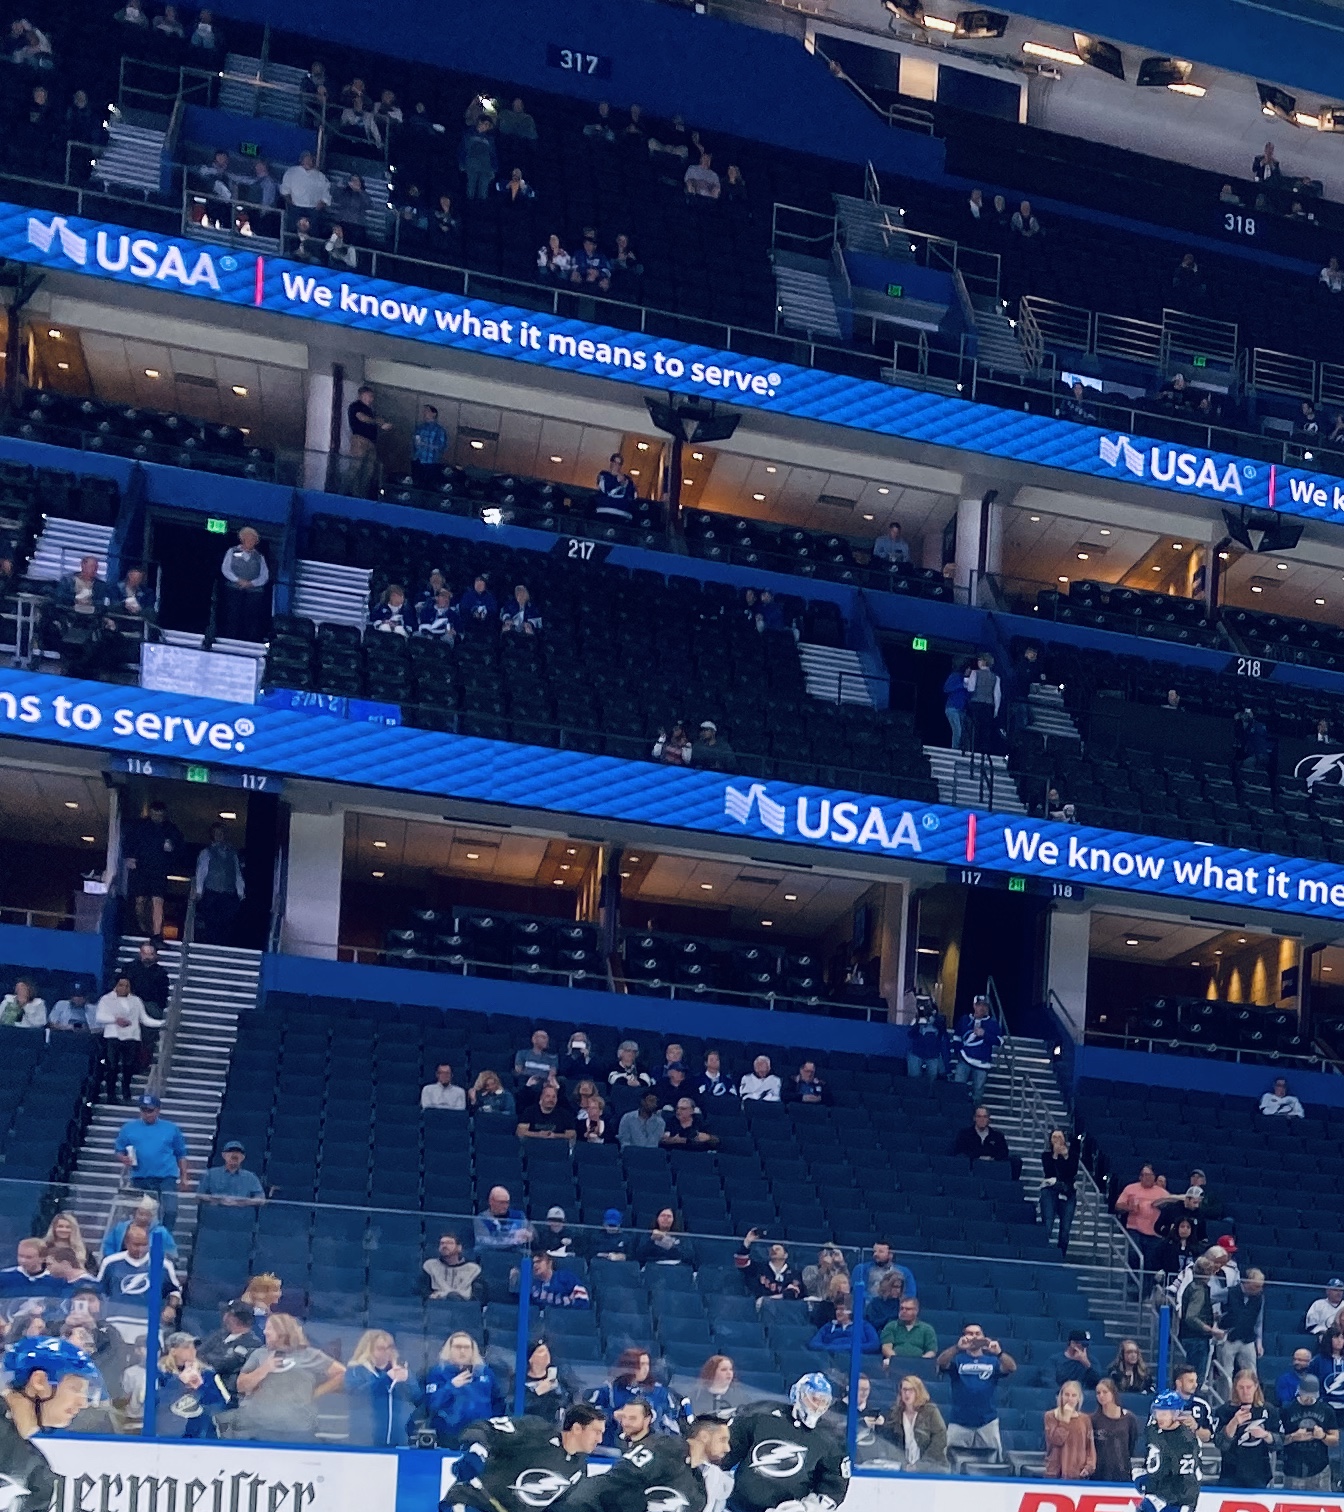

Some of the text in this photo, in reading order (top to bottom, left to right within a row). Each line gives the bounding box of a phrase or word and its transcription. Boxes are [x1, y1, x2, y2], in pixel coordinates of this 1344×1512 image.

[560, 49, 598, 74] 317
[1225, 213, 1254, 236] 318
[282, 272, 334, 308] We
[340, 283, 428, 326] know
[434, 308, 514, 344] what
[520, 321, 542, 350] it
[548, 333, 647, 371] means
[653, 351, 685, 378] to
[1289, 478, 1328, 507] We
[568, 539, 595, 561] 217
[1238, 658, 1260, 678] 218
[52, 695, 102, 731] to
[126, 758, 153, 775] 116
[241, 774, 268, 791] 117
[1004, 828, 1059, 865] We
[1068, 836, 1165, 880] know
[1172, 856, 1259, 895] what
[1267, 866, 1291, 899] it
[961, 871, 981, 885] 117
[1052, 883, 1072, 898] 118
